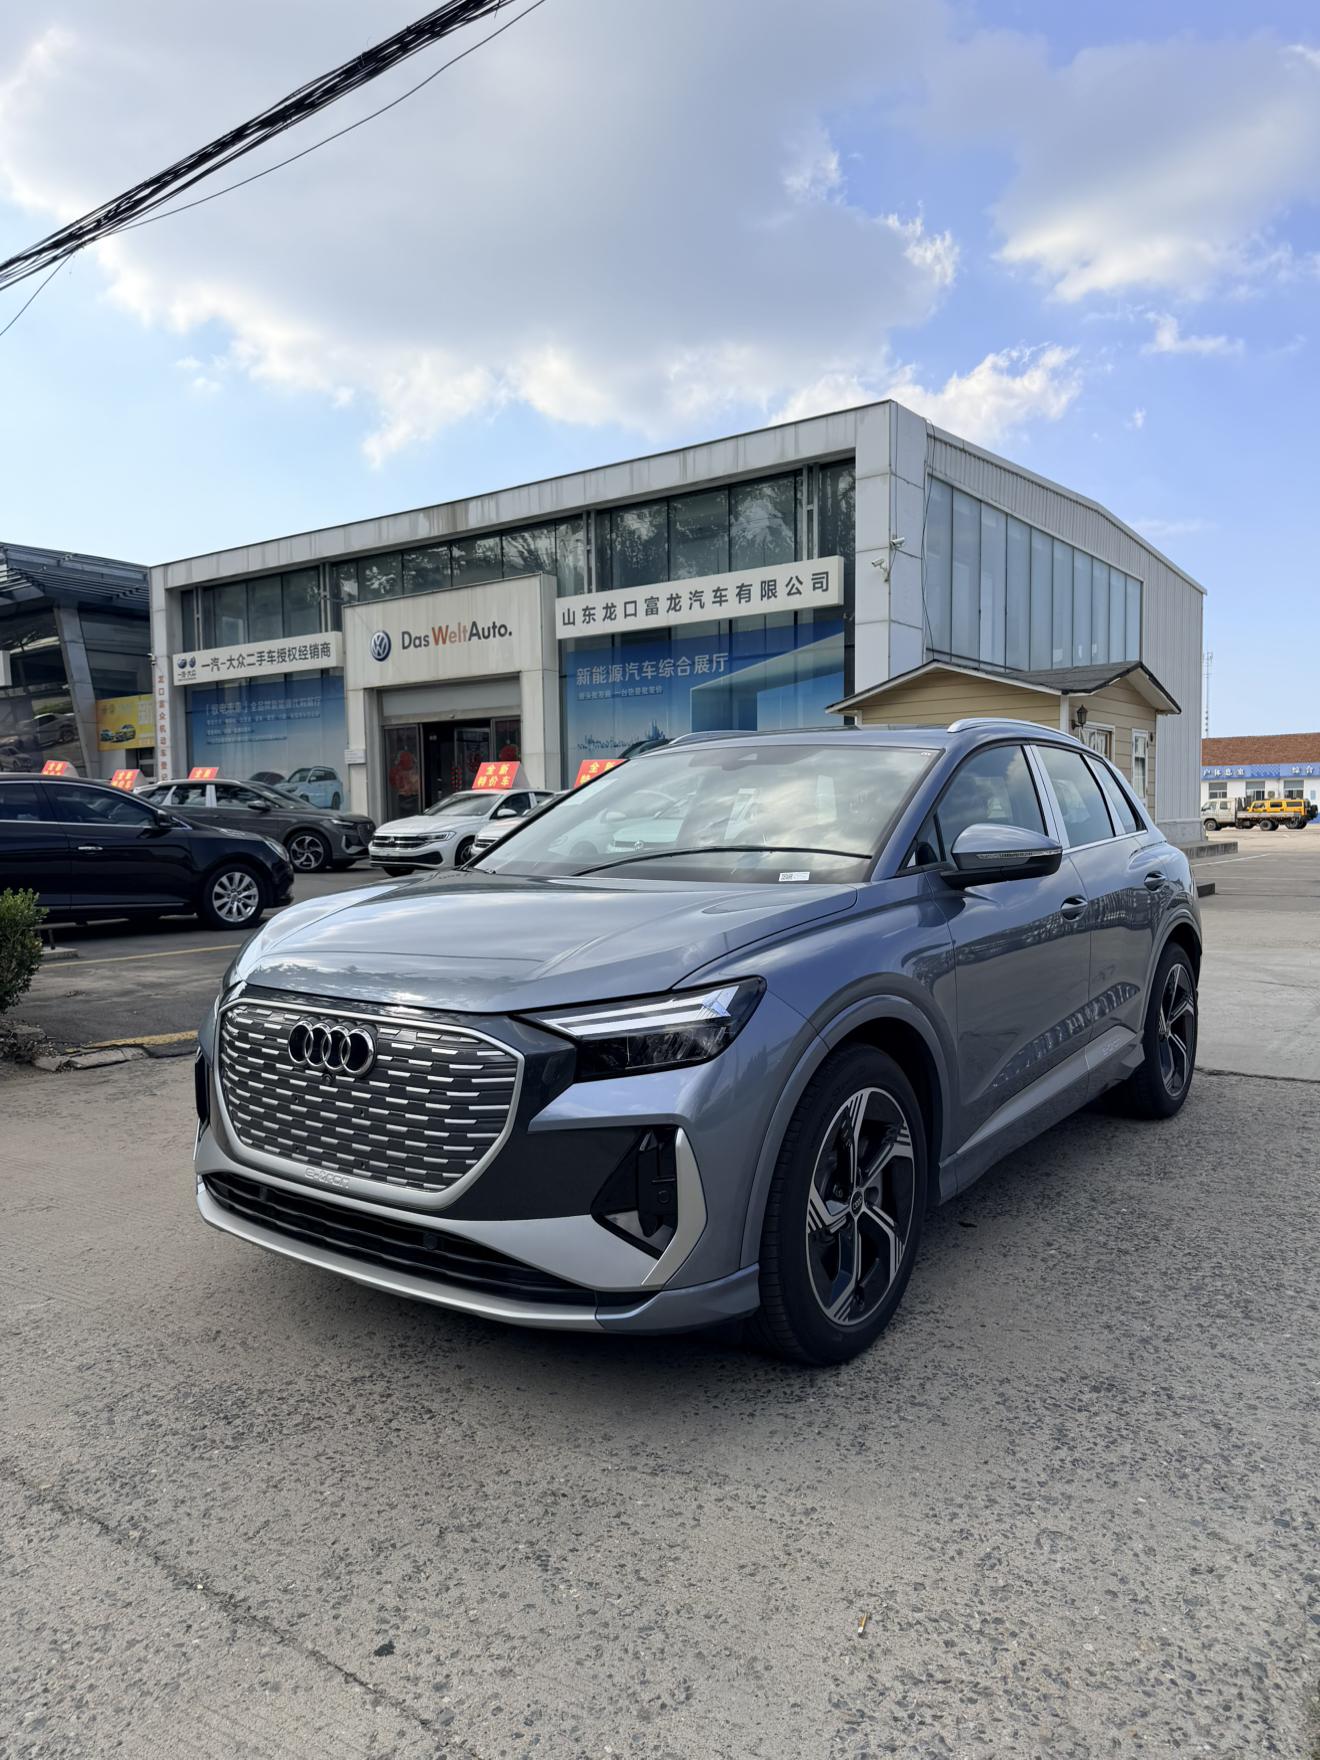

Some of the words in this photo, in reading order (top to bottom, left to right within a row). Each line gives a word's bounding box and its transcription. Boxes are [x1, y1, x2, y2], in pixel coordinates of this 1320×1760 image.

[562, 570, 830, 627] 山东龙口富龙汽车有限公司
[401, 630, 430, 651] Das
[431, 620, 513, 647] WeltAuto.
[201, 642, 331, 673] 一汽-大众二手车授权经销商
[576, 652, 729, 687] 新能源汽车综合展厅
[477, 775, 511, 787] 特价车
[485, 763, 511, 776] 全新
